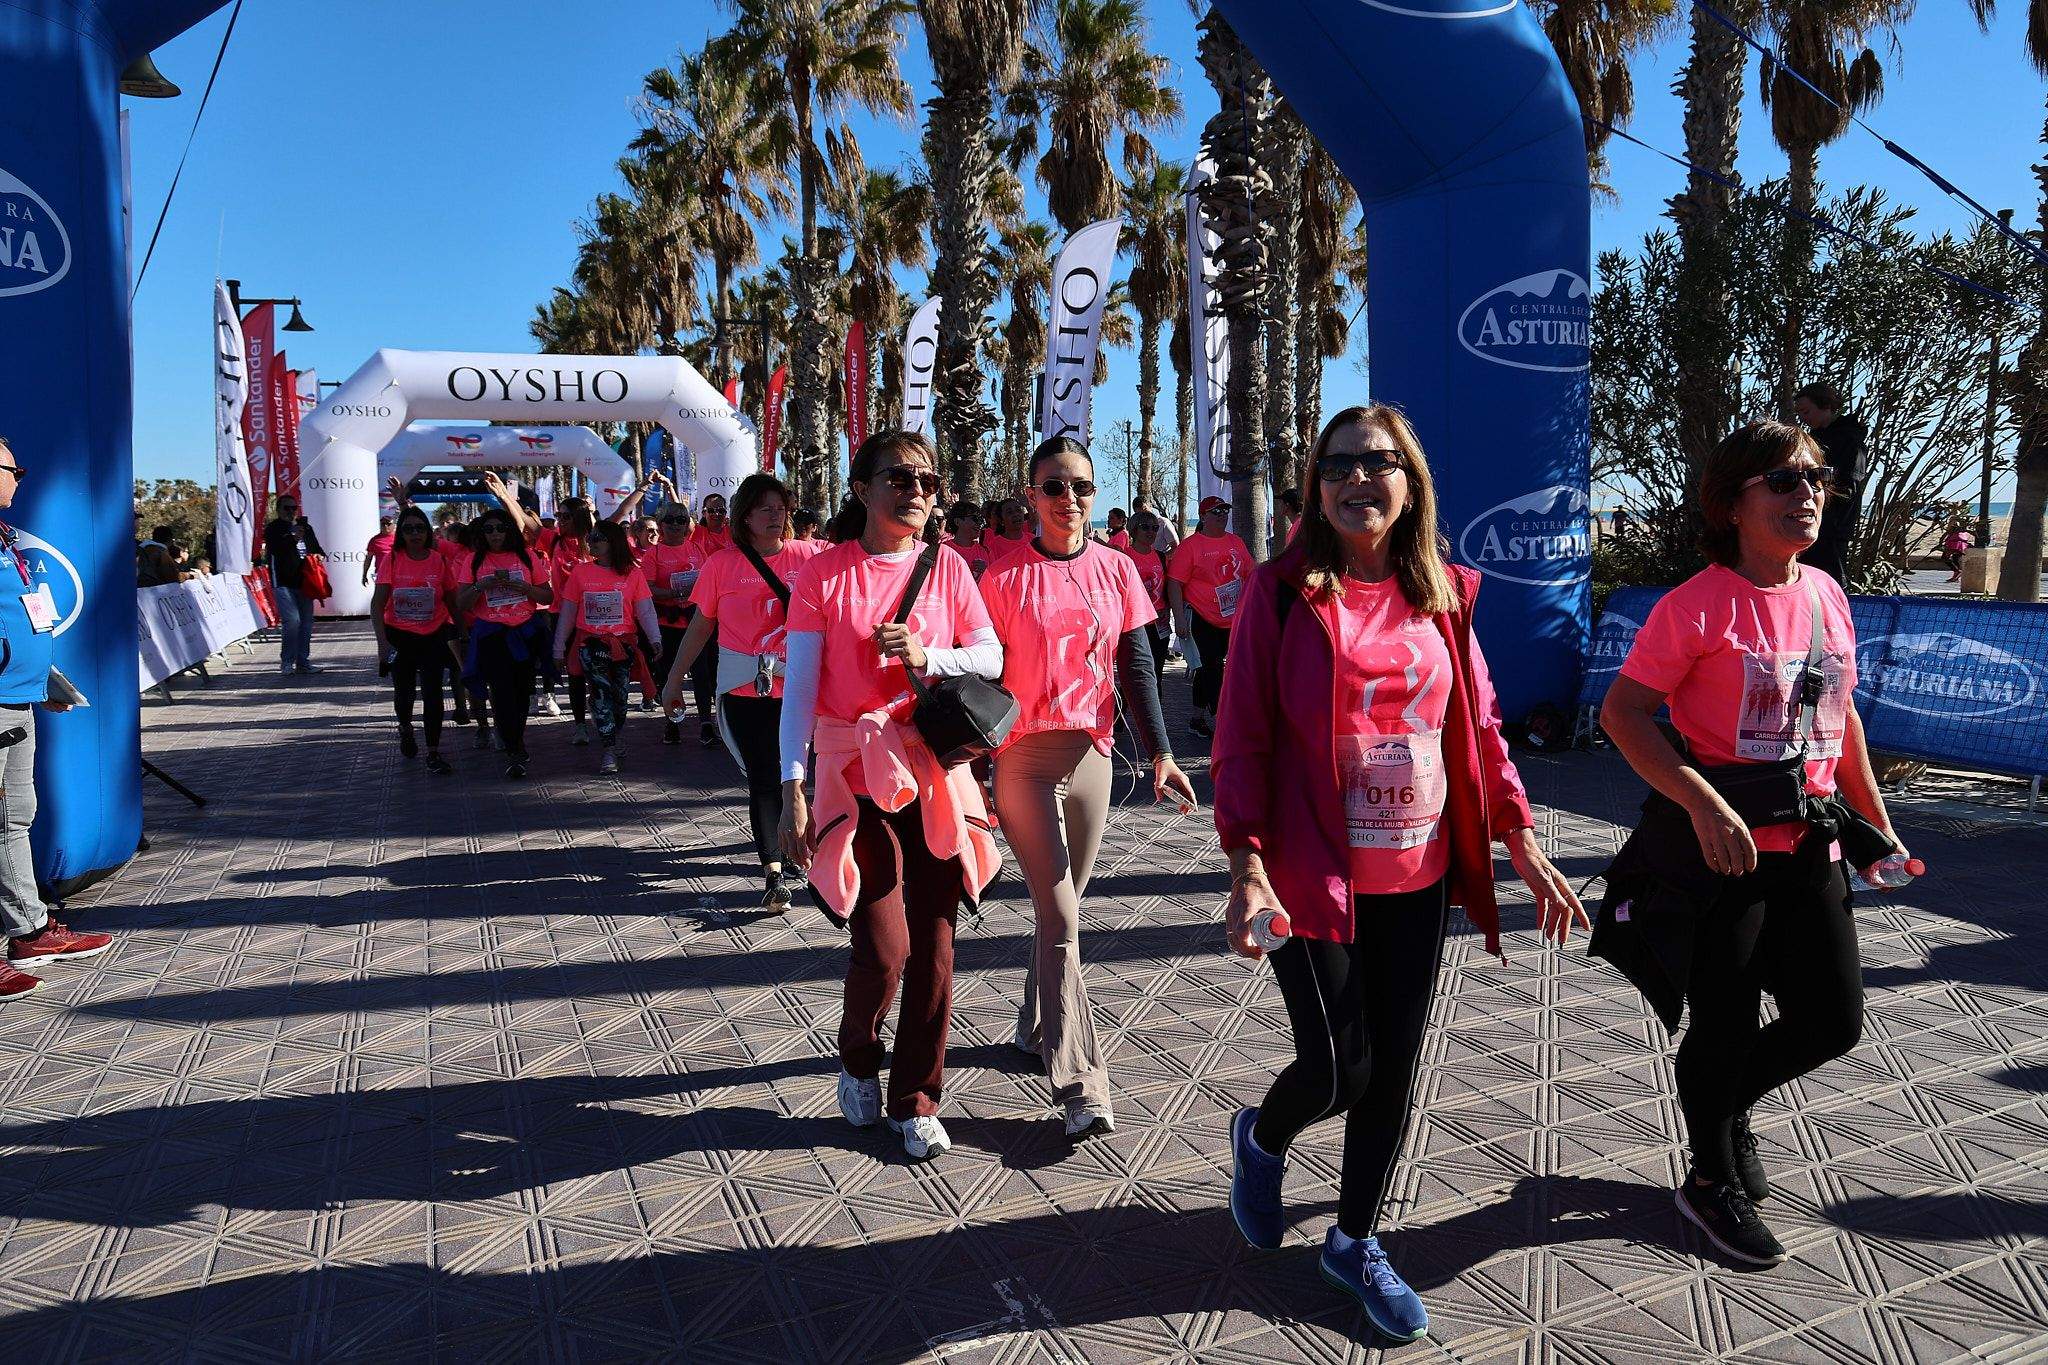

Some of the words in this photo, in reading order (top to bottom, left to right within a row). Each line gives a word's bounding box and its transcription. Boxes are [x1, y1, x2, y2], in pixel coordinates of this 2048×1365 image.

[1510, 305, 1568, 314] CENTRAL
[1475, 307, 1590, 346] ASTURIA
[1051, 267, 1099, 438] YSHO
[248, 337, 266, 442] Santander
[447, 366, 628, 403] OYSHO
[849, 350, 860, 446] Santander
[331, 405, 391, 417] OYSHO
[678, 408, 728, 419] OYSHO
[274, 378, 290, 465] Santander
[309, 478, 364, 490] OYSHO
[418, 479, 479, 487] VOLV
[1511, 520, 1568, 531] CENTRAL
[1477, 525, 1591, 562] ASTURIA
[325, 551, 367, 563] YSHO
[841, 597, 881, 607] OYSHO
[1366, 752, 1412, 762] ASTURIANA
[1366, 786, 1415, 805] 016
[1379, 811, 1396, 819] 421
[1384, 821, 1405, 829] MUJER
[1349, 832, 1376, 842] SHO
